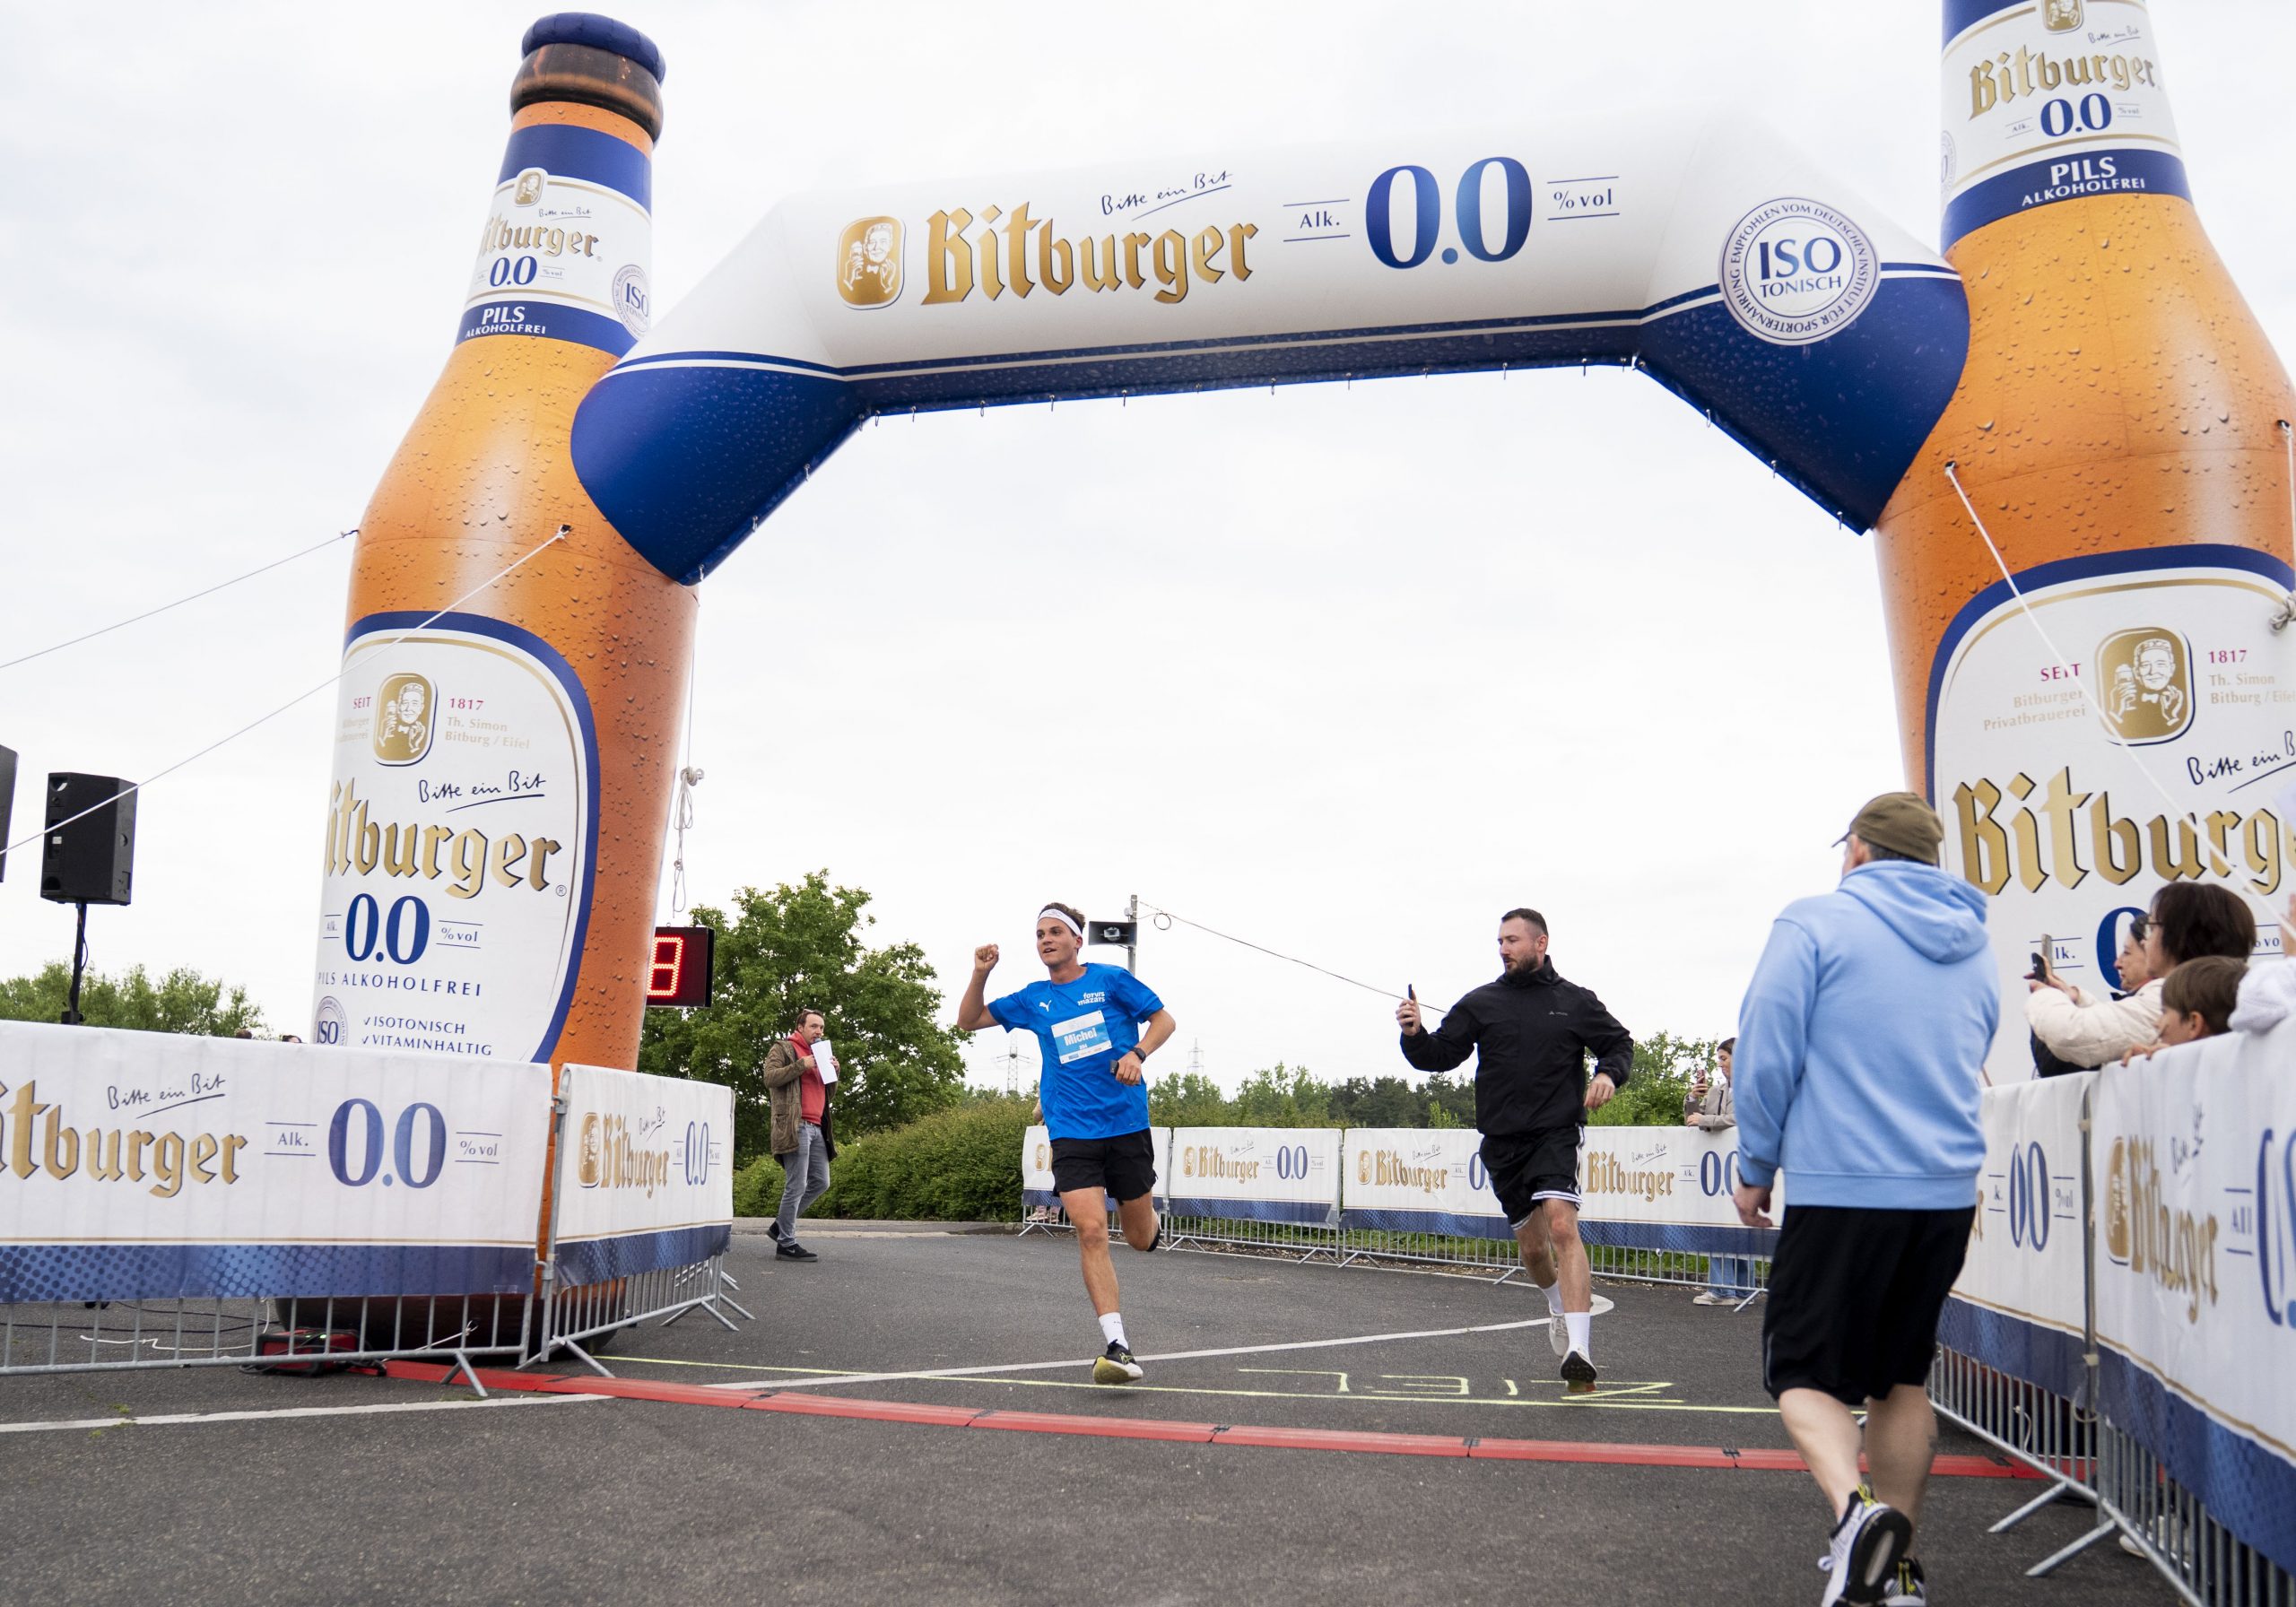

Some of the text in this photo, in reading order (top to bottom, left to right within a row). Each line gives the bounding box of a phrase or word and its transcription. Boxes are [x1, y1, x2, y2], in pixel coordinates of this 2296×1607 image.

[1969, 44, 2154, 121] Bitburger
[2040, 93, 2112, 136] 0.0
[2050, 157, 2117, 186] PILS
[1101, 169, 1233, 215] Bitte ein Bit
[2022, 178, 2145, 206] ALKOHOLFREI
[1300, 211, 1341, 229] Alk.
[1366, 156, 1533, 269] 0.0
[921, 201, 1259, 306] Bitburger
[1729, 204, 1869, 334] EMPFOHLEN VOM DEUTSCHEN INSTITUT FÜR SPORTERNÄHRUNG
[1760, 237, 1842, 280] ISO
[490, 256, 537, 287] 0.0
[1760, 275, 1841, 298] TONISCH
[482, 306, 525, 325] PILS
[626, 282, 649, 317] ISO
[465, 323, 546, 338] ALKOHOLFREI
[2040, 650, 2247, 682] SEIT 1817
[2209, 673, 2275, 686] Th. Simon
[353, 697, 484, 711] SEIT 1817
[2013, 690, 2083, 708] Bitburger
[2210, 691, 2261, 705] Bitburg
[447, 716, 509, 732] Th. Simon
[1984, 704, 2086, 731] Privatbrauerei
[445, 731, 490, 747] Bitburg
[504, 736, 530, 749] Eifel
[2187, 750, 2281, 786] Bitte ein
[419, 770, 546, 803] Bitte ein Bit
[326, 777, 562, 899] itburger
[345, 892, 430, 965] 0.0
[2056, 946, 2076, 960] lk.
[317, 971, 481, 996] PILS ALKOHOLFREI
[1077, 996, 1105, 1005] mazars
[317, 1021, 338, 1044] ISO
[374, 1017, 465, 1035] ISOTONISCH
[373, 1035, 492, 1056] VITAMINHALTIG
[108, 1073, 226, 1109] Bitte ein Bit
[0, 1079, 248, 1198] tburger
[277, 1133, 309, 1148] Alk.
[328, 1098, 447, 1189] 0.0
[601, 1112, 709, 1199] Bitburger 0.0
[1198, 1145, 1259, 1184] Bitburger
[1277, 1145, 1308, 1180] 0.0
[1375, 1150, 1448, 1193] Bitburger
[1469, 1151, 1492, 1190] 0.
[1586, 1151, 1674, 1203] Bitburger
